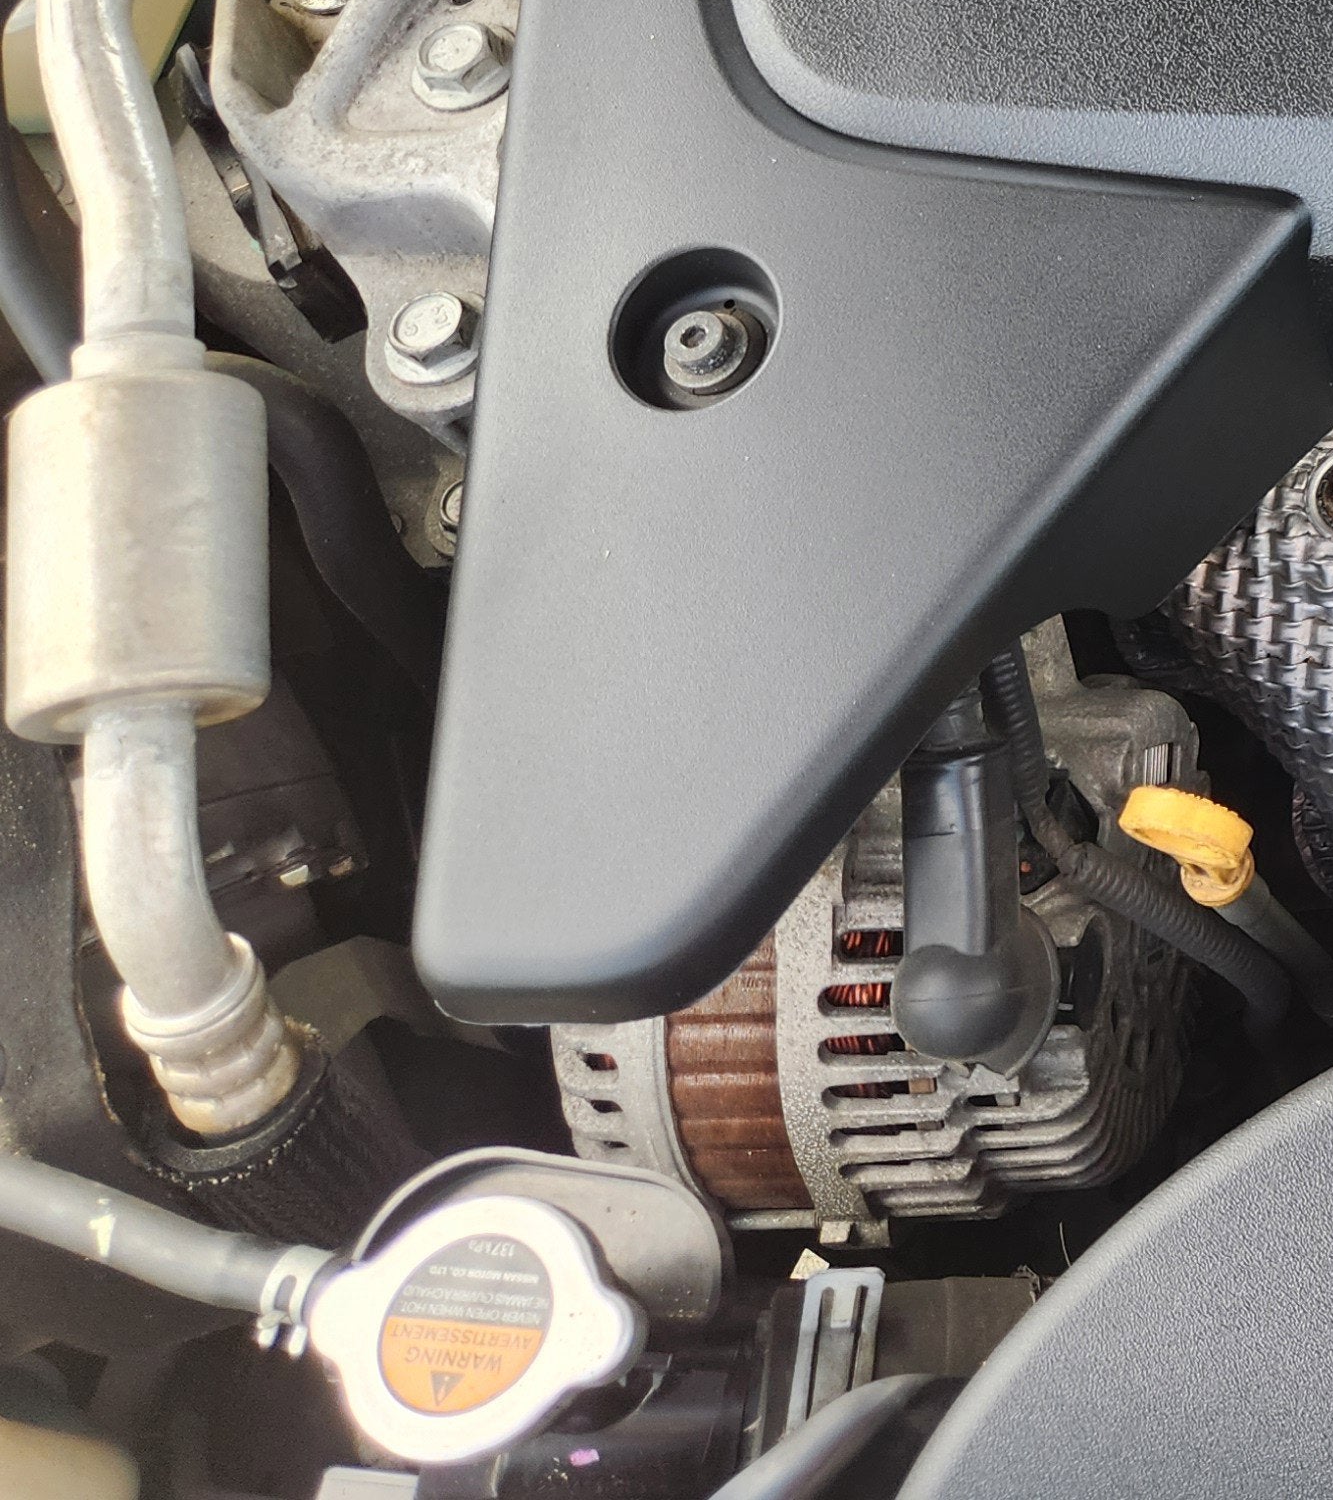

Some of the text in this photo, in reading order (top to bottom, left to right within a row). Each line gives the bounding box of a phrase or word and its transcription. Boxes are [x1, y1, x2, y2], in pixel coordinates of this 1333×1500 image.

[467, 1269, 502, 1280] MOTOR
[430, 1303, 468, 1318] WHEN
[467, 1307, 500, 1321] OPEN
[502, 1312, 541, 1325] NEVER
[391, 1323, 535, 1350] AVERTISSEMENT
[404, 1346, 503, 1375] WARNING
